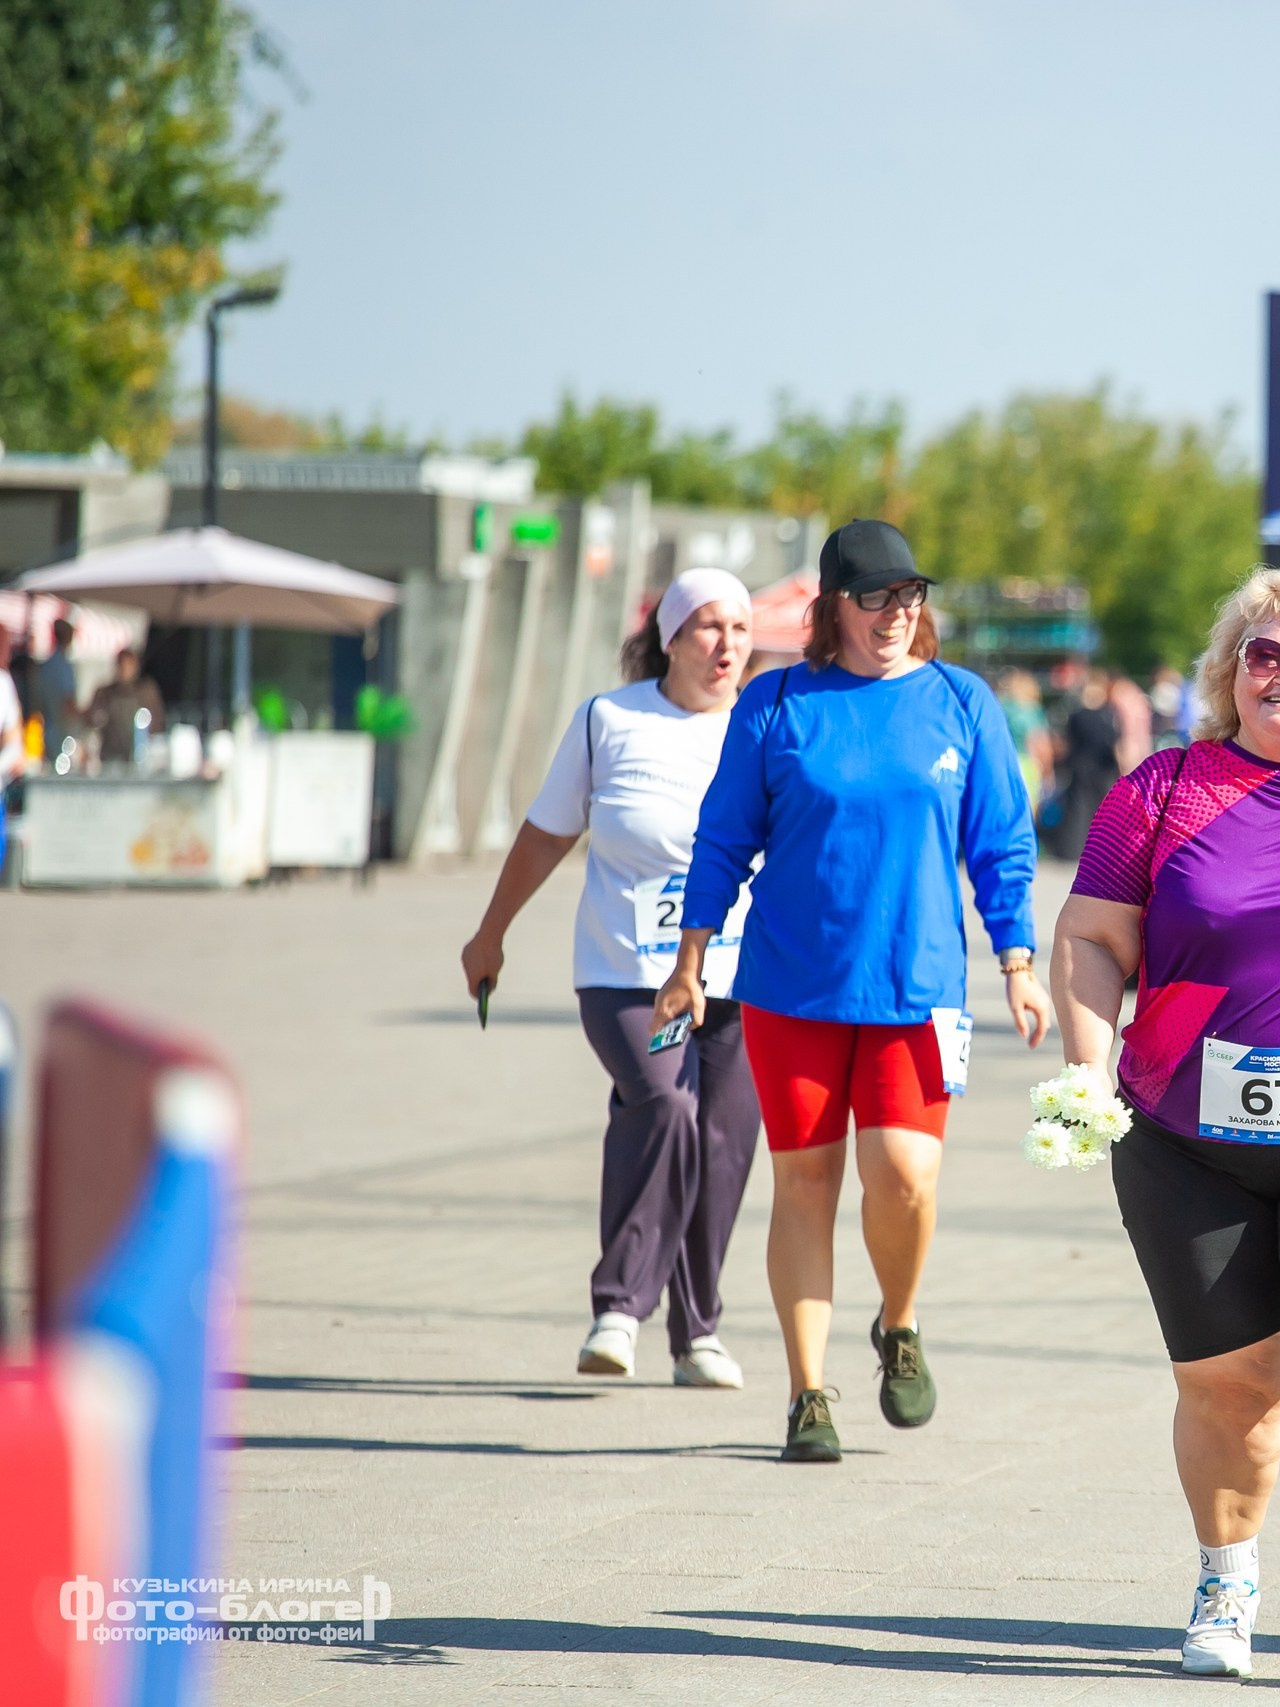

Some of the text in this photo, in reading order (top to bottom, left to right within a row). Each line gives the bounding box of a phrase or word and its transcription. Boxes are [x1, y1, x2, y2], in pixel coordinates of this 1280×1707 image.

[657, 900, 684, 927] 2
[1216, 1052, 1234, 1061] СБЕР
[1228, 1115, 1275, 1127] ЗАХАРОВА
